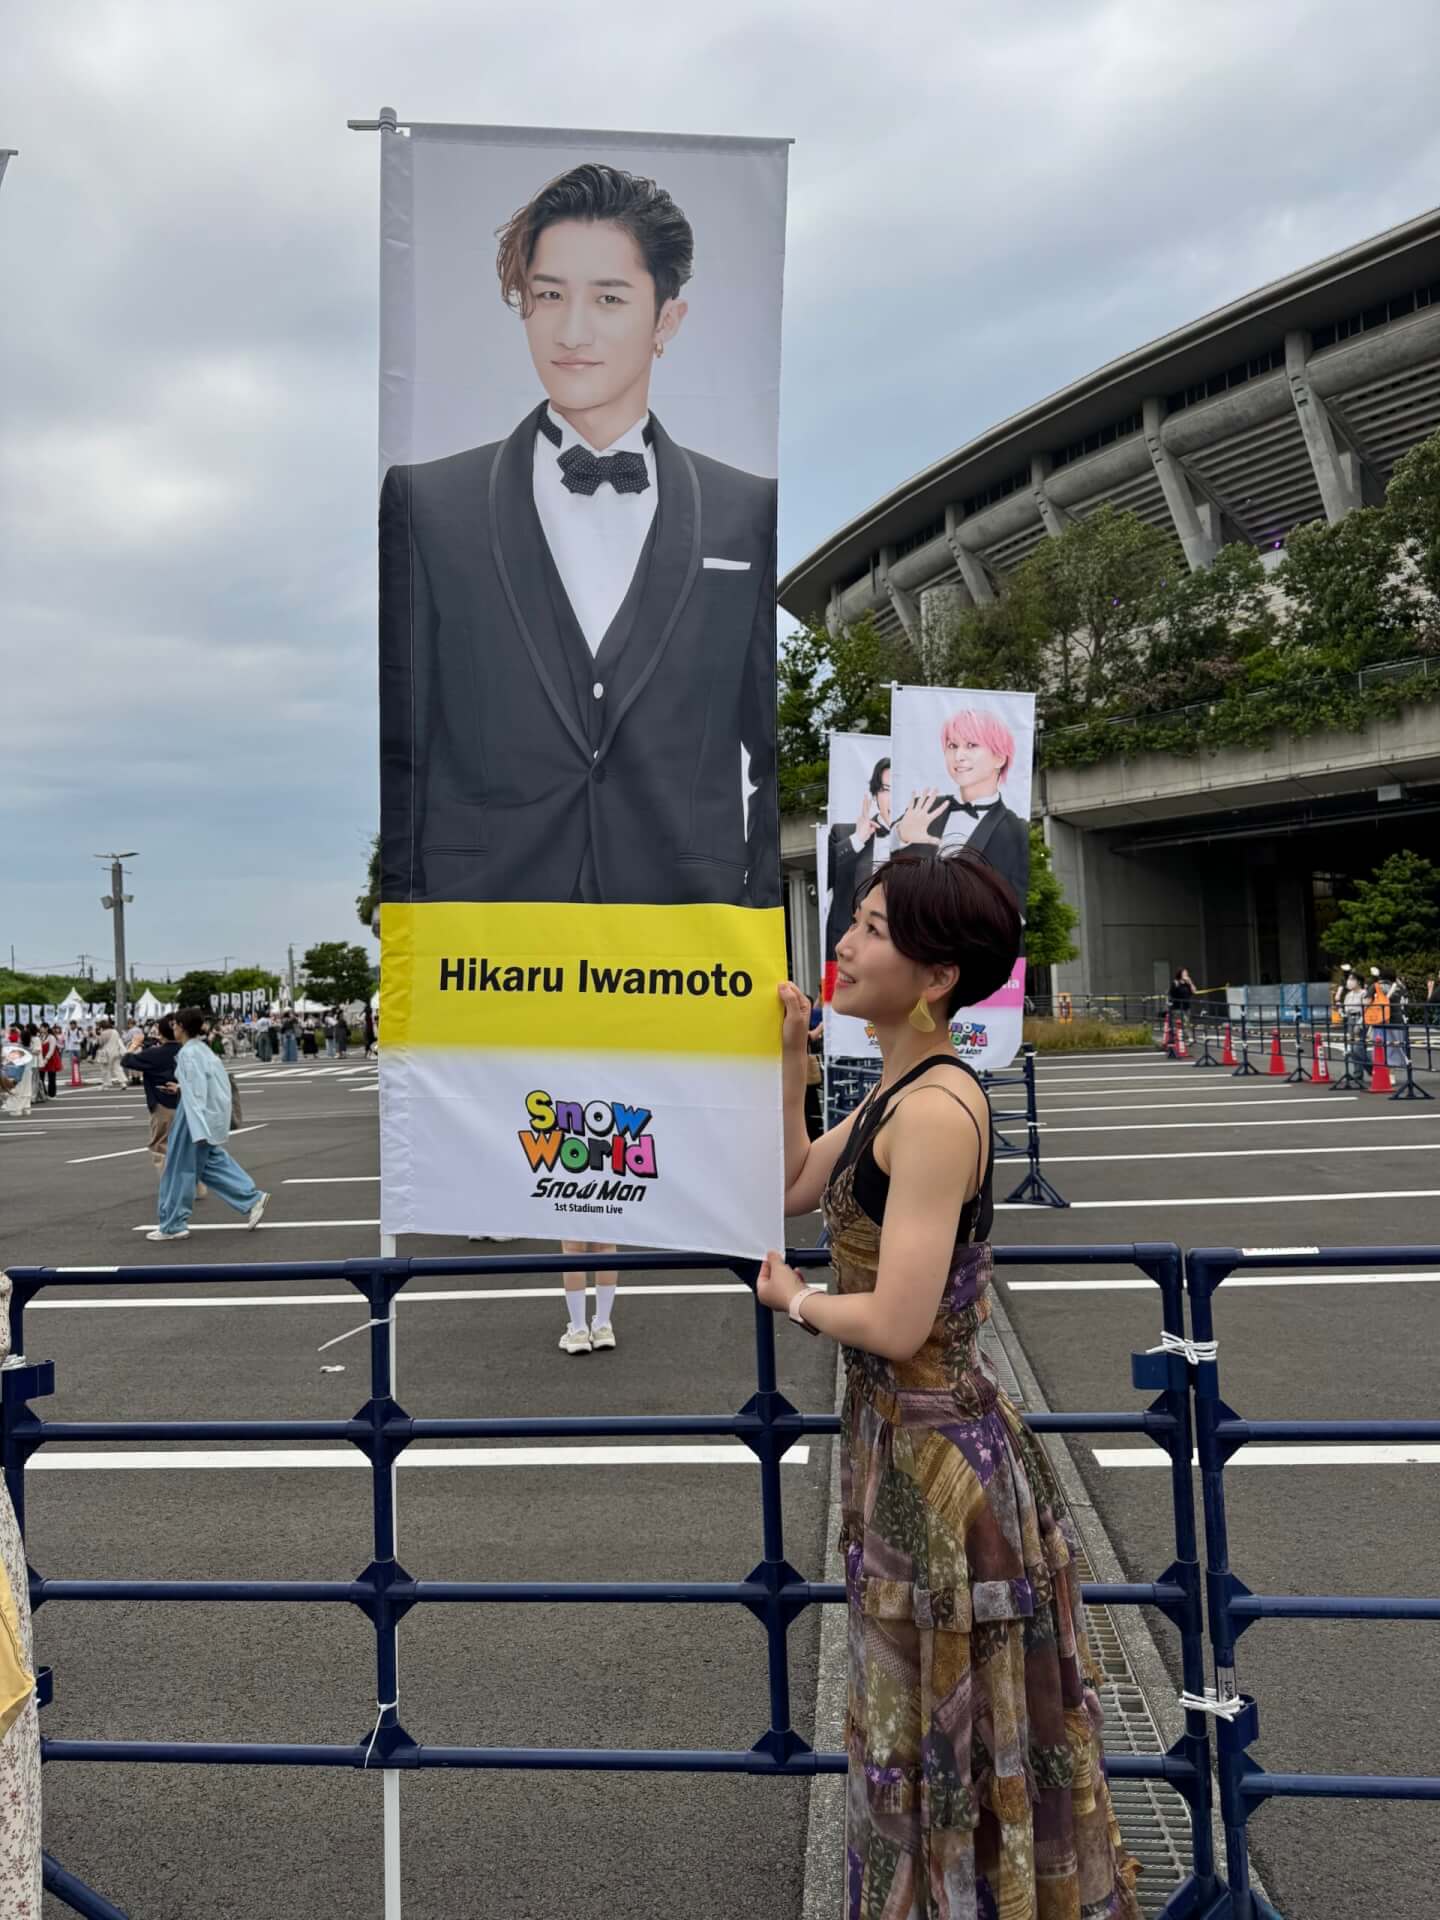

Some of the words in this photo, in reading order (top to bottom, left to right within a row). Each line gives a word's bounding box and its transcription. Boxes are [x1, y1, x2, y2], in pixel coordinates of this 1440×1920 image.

[439, 957, 564, 993] Hikaru
[578, 959, 753, 998] Iwamoto
[948, 1022, 986, 1034] now
[949, 1032, 988, 1047] orld
[525, 1089, 653, 1141] Snow
[518, 1129, 659, 1179] World
[530, 1177, 598, 1199] Snow
[596, 1180, 647, 1202] Man
[554, 1202, 567, 1212] 1st
[568, 1203, 604, 1213] Stadium
[606, 1204, 623, 1214] Live
